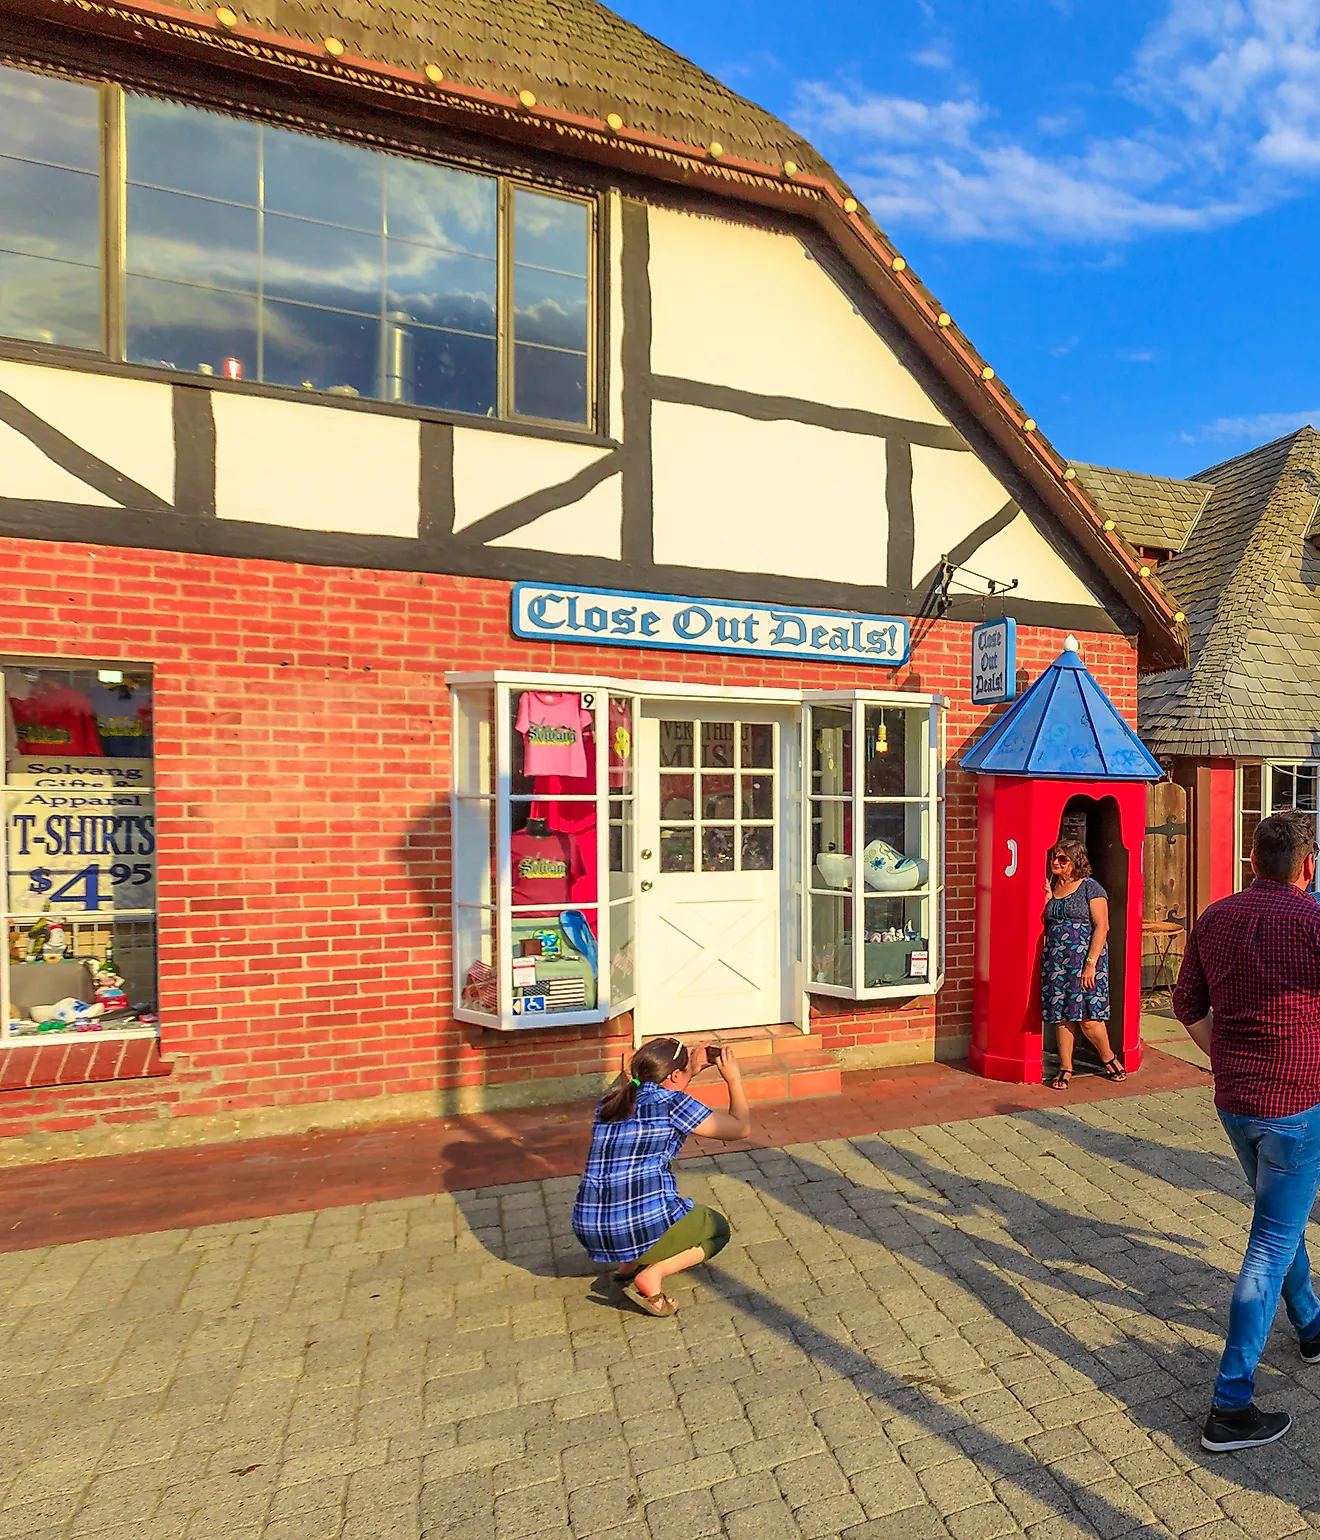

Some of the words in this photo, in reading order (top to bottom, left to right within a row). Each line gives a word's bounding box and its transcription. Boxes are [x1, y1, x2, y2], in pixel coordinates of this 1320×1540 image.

[527, 593, 661, 637] Close
[673, 605, 759, 645] Out
[768, 609, 899, 656] Deals!
[978, 630, 1002, 651] Close
[980, 652, 998, 672] Out
[975, 672, 1003, 695] Deals!
[583, 693, 595, 708] 9
[27, 763, 143, 779] Solvang
[26, 794, 143, 808] Apparel
[12, 814, 155, 855] T-SHIRTS
